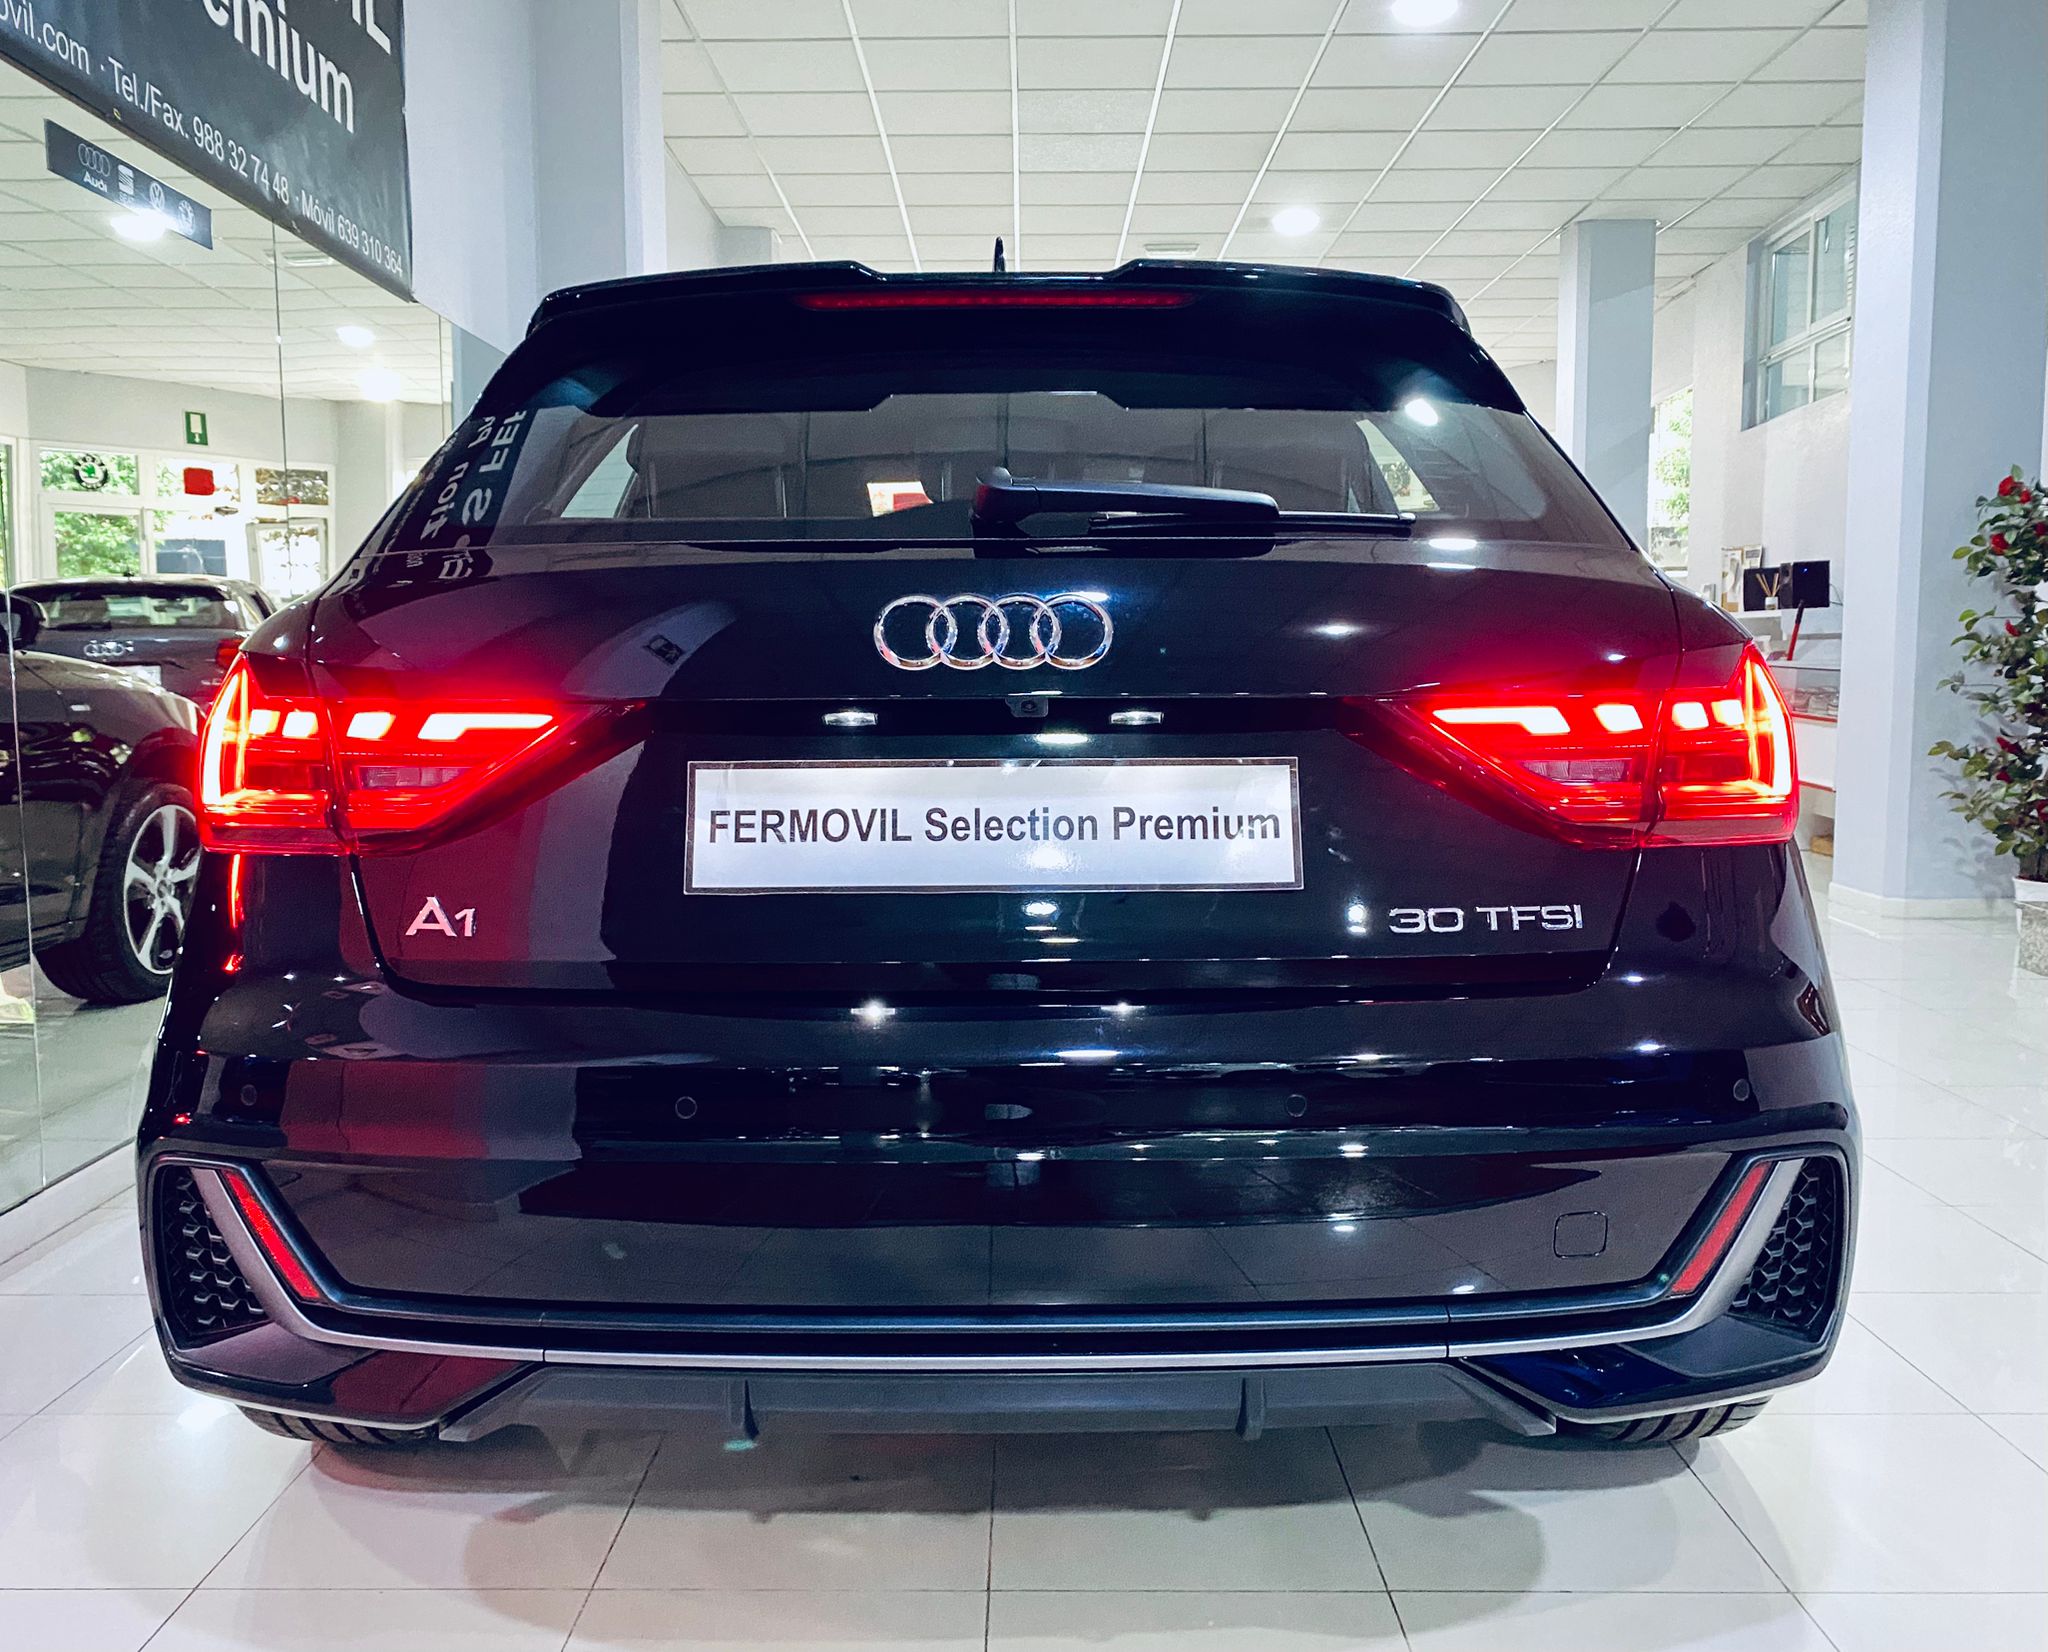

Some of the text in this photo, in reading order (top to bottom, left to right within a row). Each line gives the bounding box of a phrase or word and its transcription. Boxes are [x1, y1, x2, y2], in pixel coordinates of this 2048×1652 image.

[83, 170, 109, 193] Audi
[107, 56, 190, 140] Tel./Fax.
[192, 115, 226, 162] 988
[227, 139, 249, 178] 32
[250, 153, 270, 193] 74
[272, 171, 290, 206] 48
[301, 189, 336, 235] Móvil
[337, 213, 360, 249] 639
[361, 230, 382, 264] 310
[383, 245, 404, 278] 364
[708, 805, 1281, 844] FERMOVIL Selection Premium
[405, 896, 476, 937] A1
[1389, 904, 1584, 934] 30 TFSI
